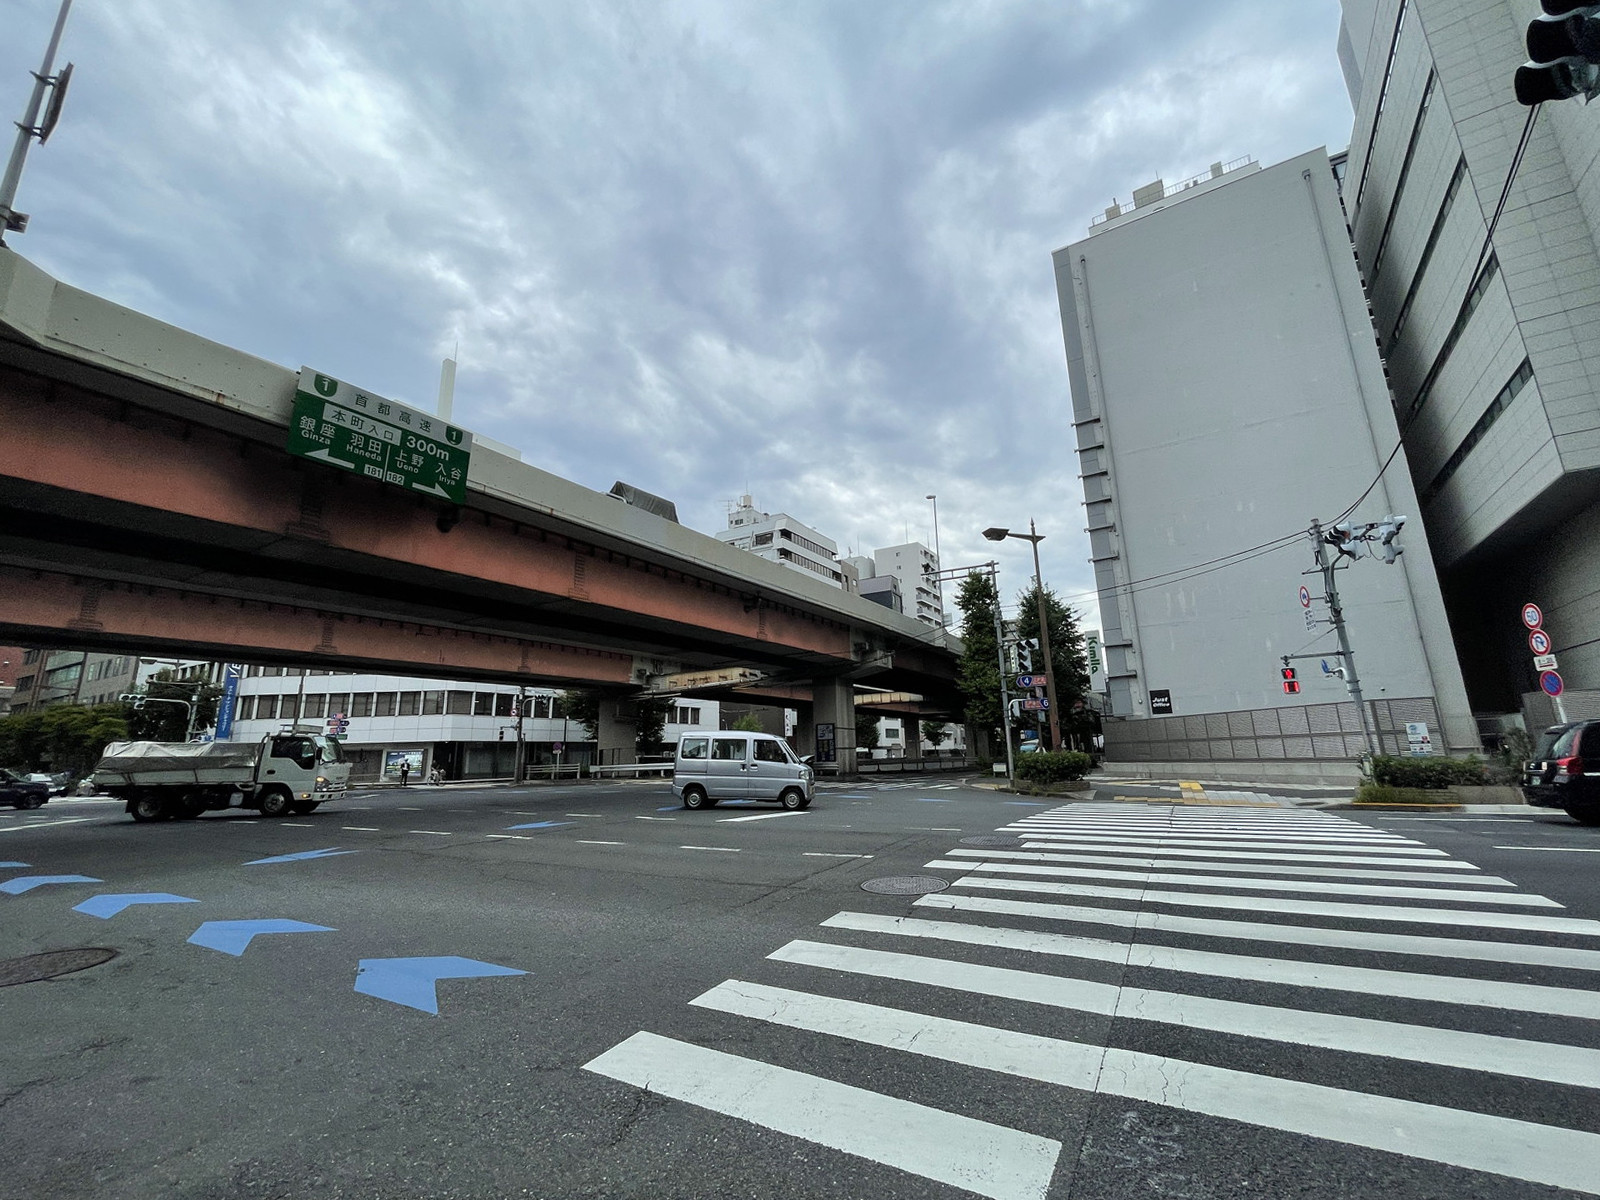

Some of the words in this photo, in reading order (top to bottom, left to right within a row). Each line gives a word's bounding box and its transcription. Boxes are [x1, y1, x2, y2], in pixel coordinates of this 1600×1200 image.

[331, 410, 393, 441] 本町入口
[356, 394, 431, 433] 首都高速
[451, 431, 457, 441] 1
[299, 415, 336, 438] 銀座
[301, 429, 331, 445] Ginza
[350, 433, 382, 453] 羽田
[346, 444, 382, 462] Haneda
[406, 436, 450, 461] 300m
[395, 449, 424, 467] 上野
[366, 466, 381, 477] 181
[396, 461, 419, 474] Ueno
[435, 463, 462, 480] 入谷
[388, 472, 404, 484] 182
[439, 475, 456, 486] Iriya
[1526, 610, 1538, 622] 50
